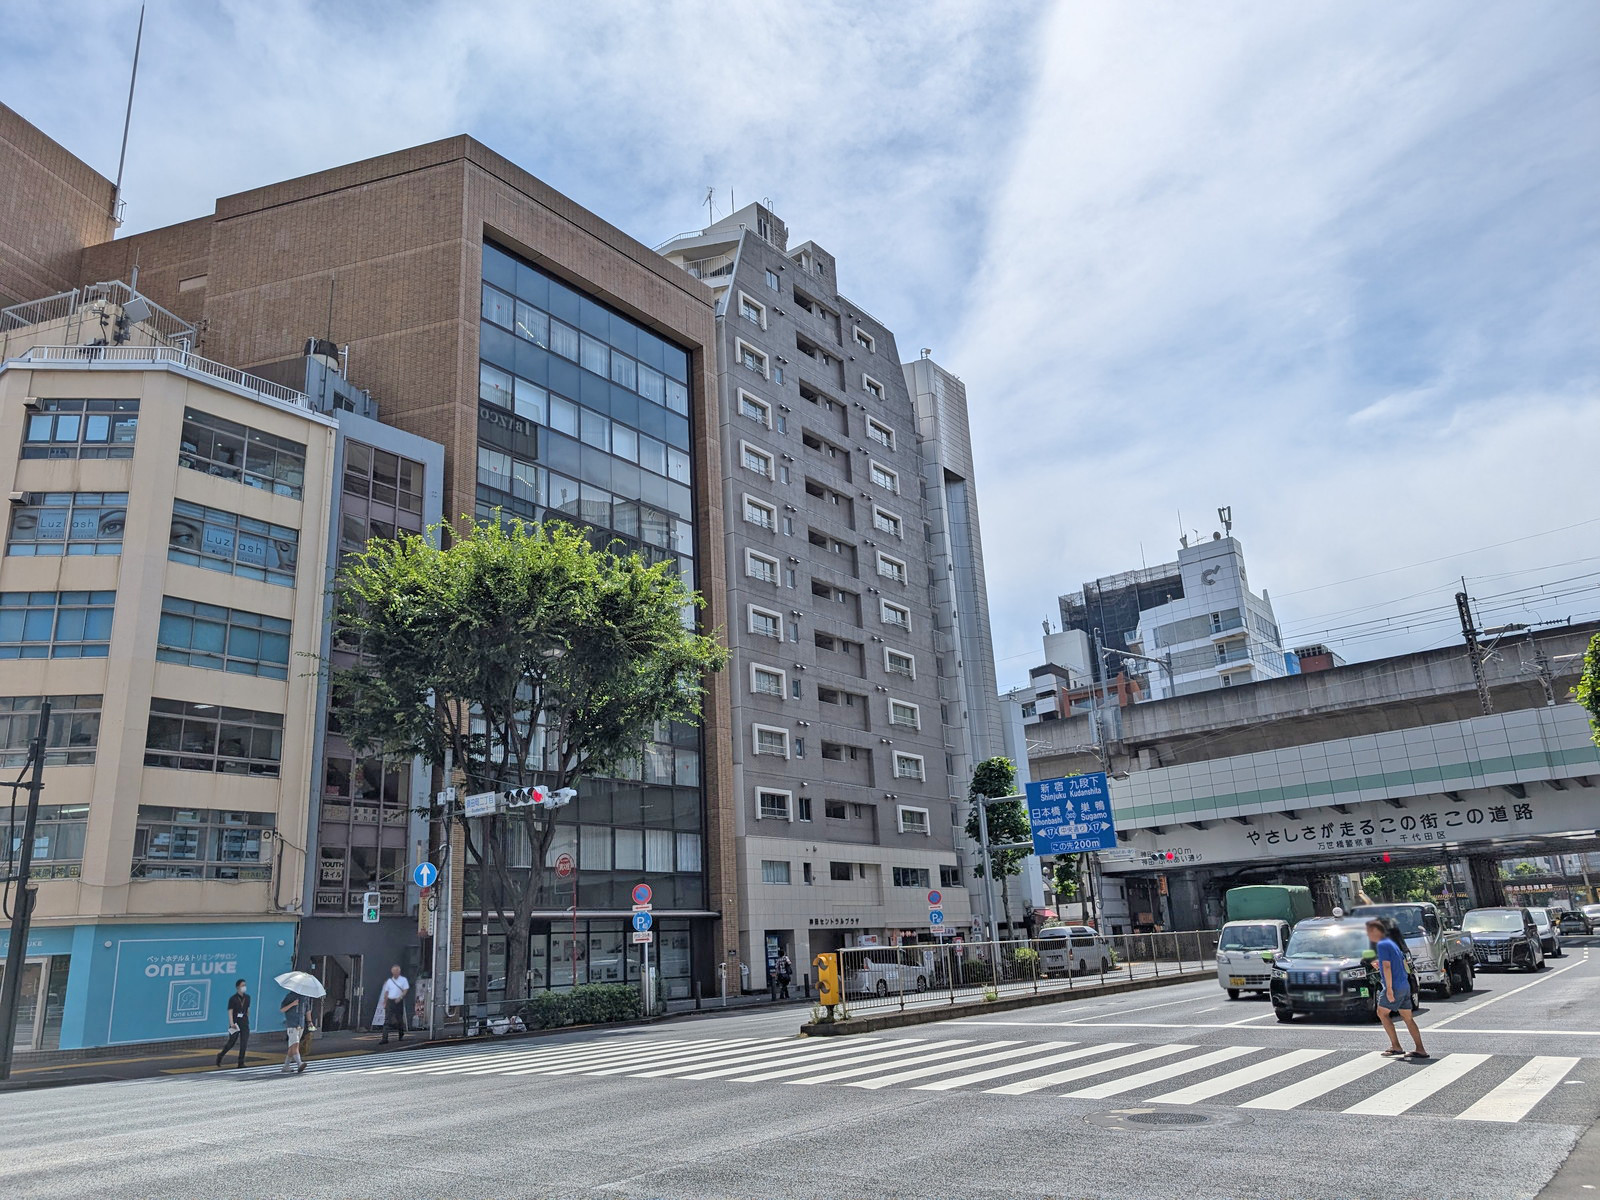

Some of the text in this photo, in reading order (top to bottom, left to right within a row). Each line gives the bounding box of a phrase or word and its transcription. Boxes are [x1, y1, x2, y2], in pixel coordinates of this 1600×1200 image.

[1040, 776, 1098, 793] 新宿 九段下
[1040, 787, 1101, 801] Shinjuku Kudanshita
[1032, 800, 1105, 818] 日本橋 巣鴨
[1032, 812, 1107, 826] Nihonbashi Sugamo
[1060, 825, 1087, 834] 中央通り
[1317, 831, 1446, 850] 万世橋警察署 千代田区
[145, 961, 237, 978] ONE LUKE
